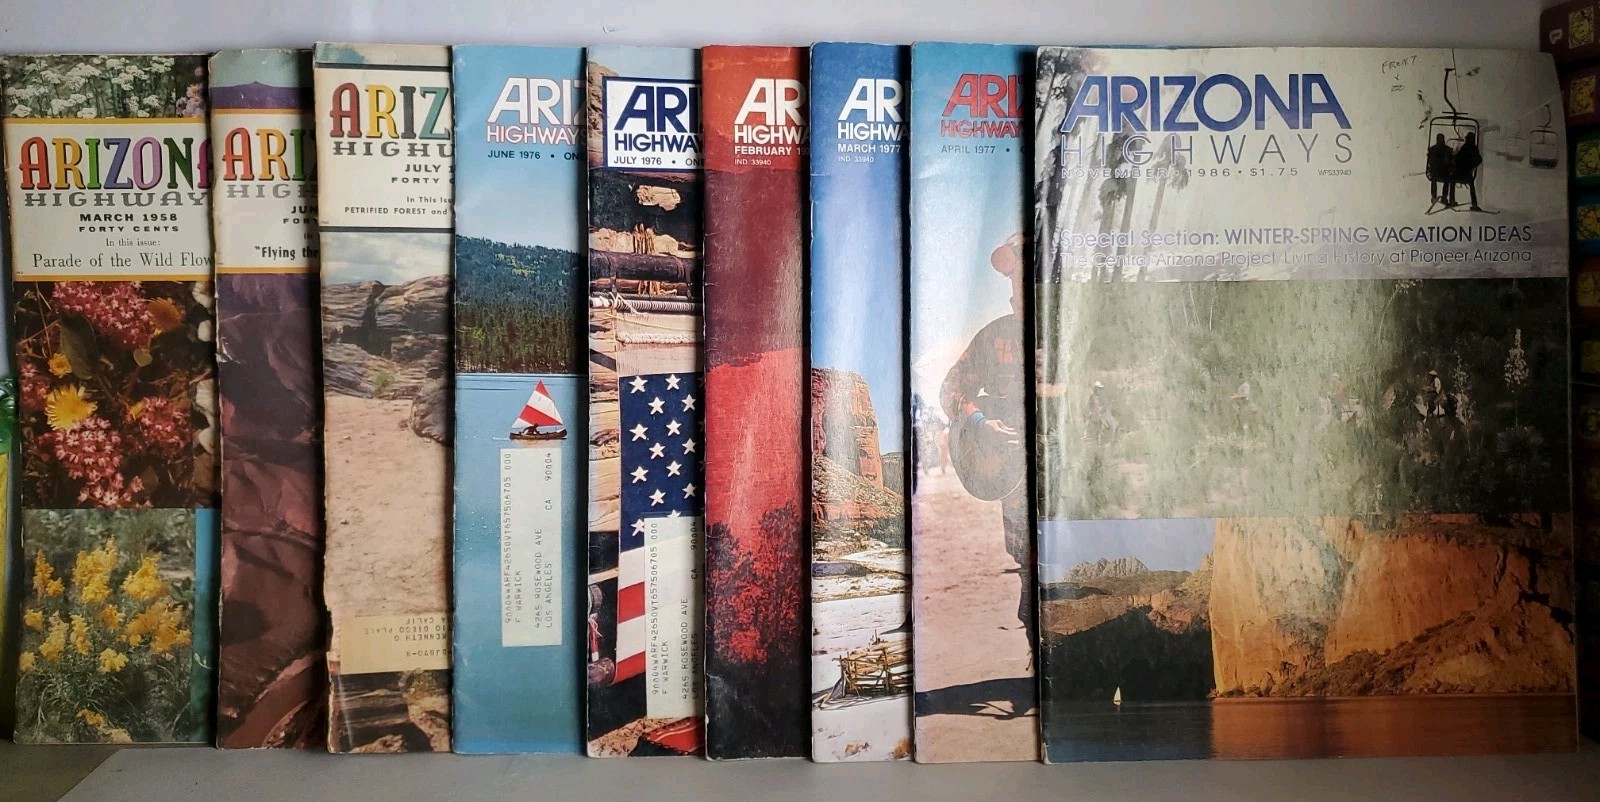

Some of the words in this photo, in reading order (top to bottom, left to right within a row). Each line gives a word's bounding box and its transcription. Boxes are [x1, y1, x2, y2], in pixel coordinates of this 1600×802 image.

[1060, 73, 1352, 133] ARIZONA
[330, 82, 450, 140] ARIZ
[222, 127, 316, 181] ARI
[735, 146, 791, 155] FEBRUARY
[838, 143, 875, 153] MARCH
[879, 143, 901, 153] 1977
[941, 146, 970, 154] APRIL
[974, 145, 996, 154] 1977
[1061, 133, 1352, 165] HIGHWAYS
[488, 150, 515, 159] JUNE
[520, 151, 541, 160] 1976
[613, 156, 637, 164] JULY
[641, 157, 662, 166] 1976
[405, 164, 441, 173] JULY
[1061, 168, 1168, 179] NOVEMBER
[1187, 168, 1231, 177] 1986
[1250, 166, 1298, 177] $1.75
[394, 207, 426, 215] FOREST
[80, 213, 134, 222] MARCH
[142, 213, 178, 222] 1958
[79, 225, 125, 233] FORTY
[133, 225, 179, 233] CENTS
[105, 238, 115, 247] In
[118, 238, 135, 247] this
[136, 238, 160, 247] issue:
[1060, 230, 1134, 248] Special
[1141, 229, 1219, 246] Section:
[1224, 226, 1369, 244] WINTER-SPRING
[1374, 226, 1472, 243] VACATION
[1478, 225, 1532, 242] IDEAS
[33, 253, 83, 268] Parade
[89, 253, 104, 268] of
[110, 253, 132, 268] the
[140, 253, 173, 268] Wild
[1060, 252, 1087, 267] The
[1092, 252, 1151, 267] Central
[1155, 252, 1216, 267] Arizona
[1221, 251, 1275, 268] Project
[1284, 250, 1328, 268] Living
[1334, 249, 1385, 266] History
[1389, 250, 1406, 263] at
[1410, 249, 1468, 263] Pioneer
[1473, 248, 1532, 262] Arizona
[545, 499, 552, 511] CA
[690, 567, 697, 580] CA
[544, 563, 552, 603] ANGELES
[514, 570, 522, 611] WARWICK
[406, 617, 434, 625] CALIF
[399, 625, 429, 633] DIEGO
[405, 633, 447, 641] KENNETH
[681, 622, 689, 669] ROSEWOOD
[681, 677, 689, 700] 4265
